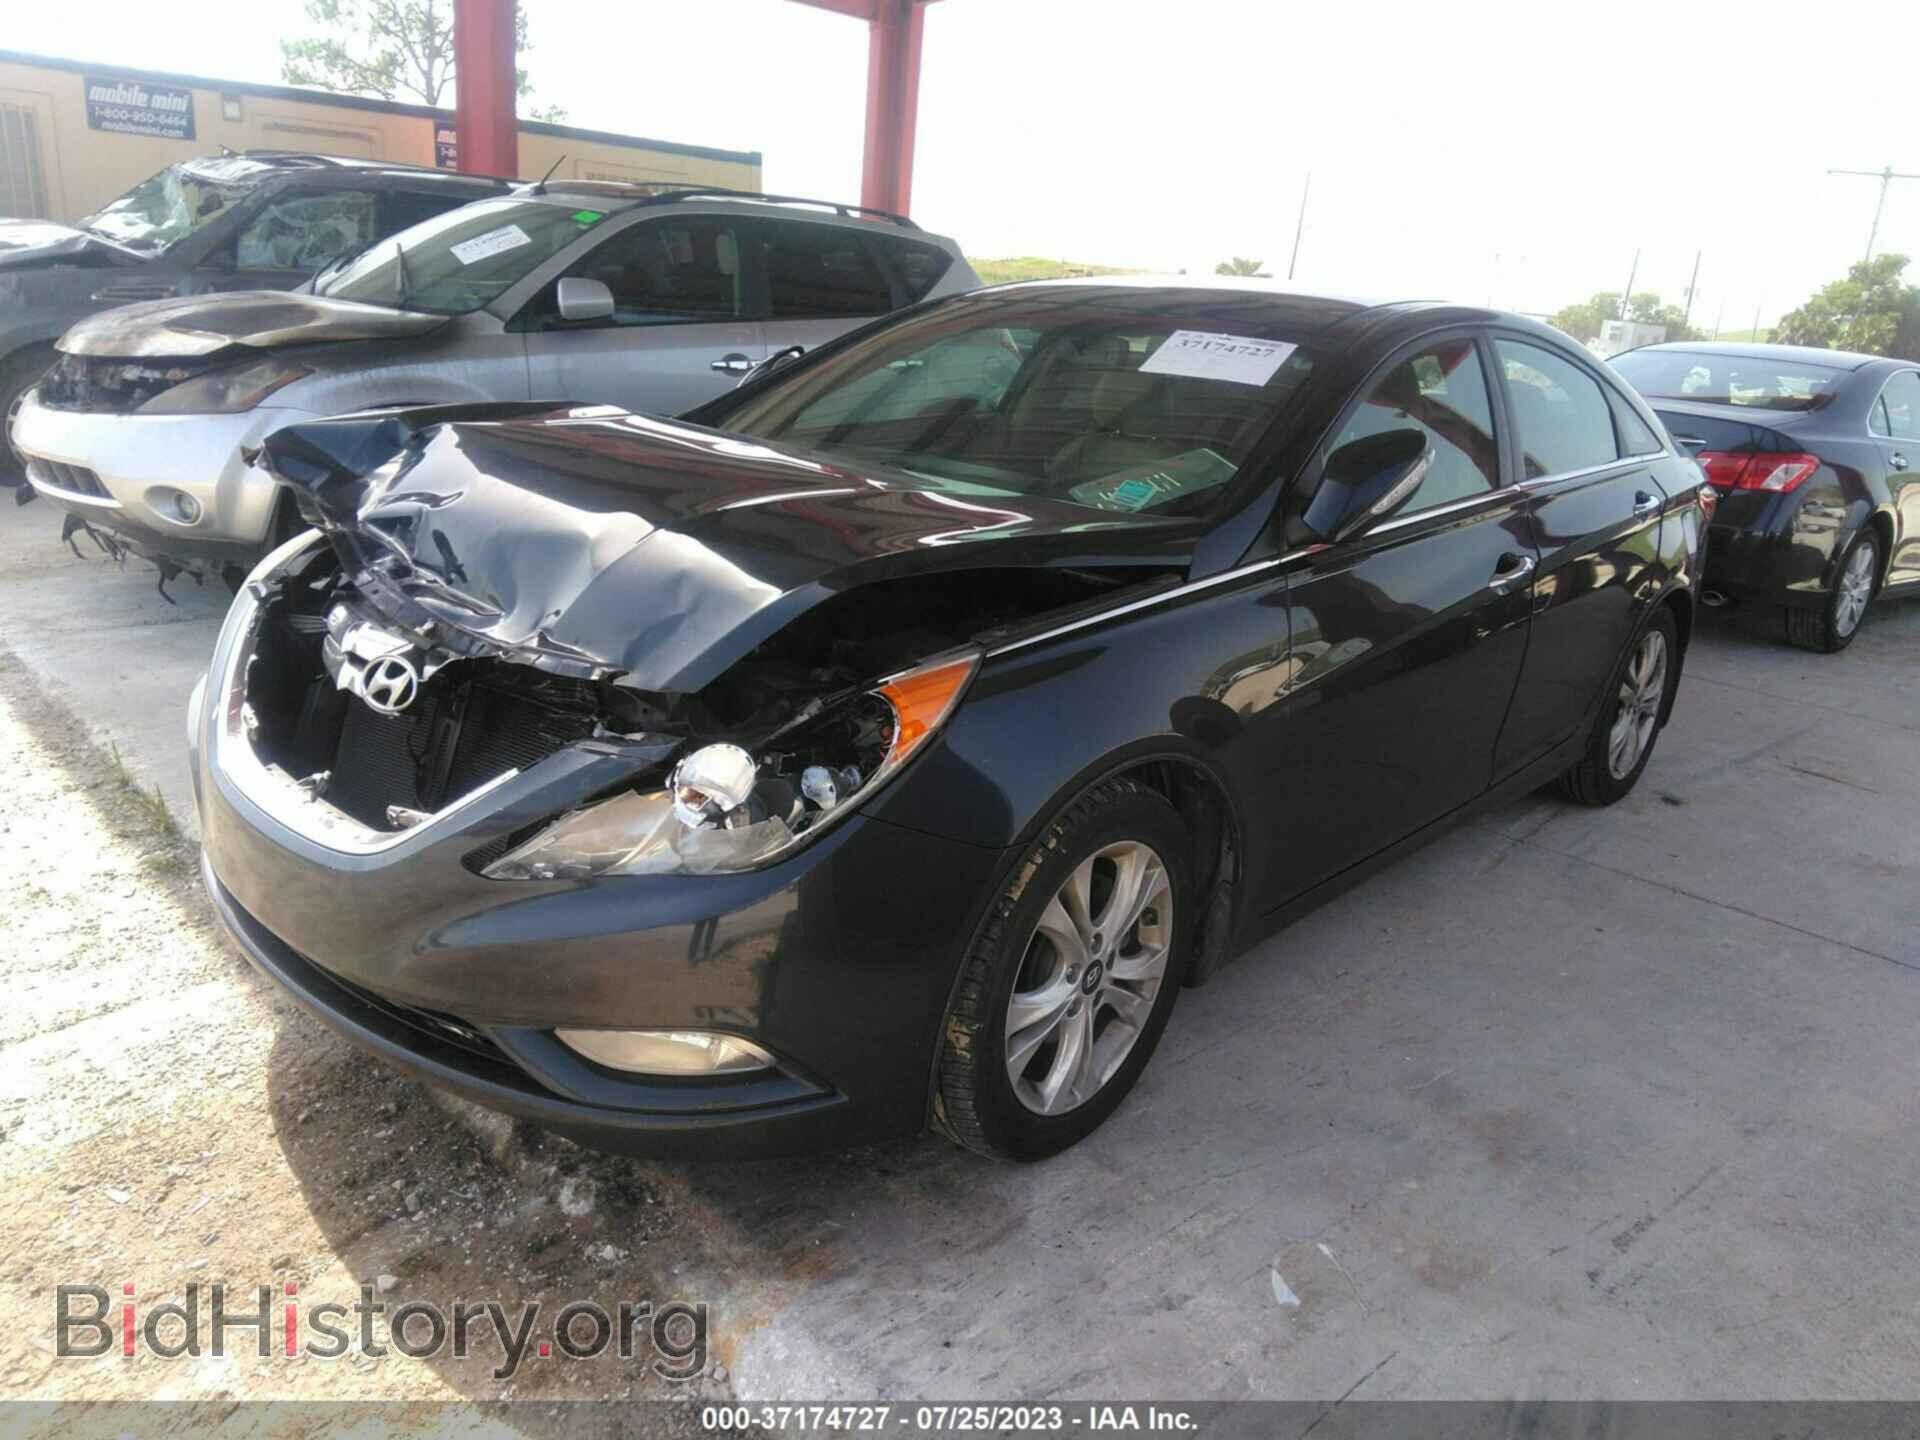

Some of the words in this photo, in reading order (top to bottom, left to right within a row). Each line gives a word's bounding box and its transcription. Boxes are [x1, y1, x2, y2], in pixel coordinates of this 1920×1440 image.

[88, 83, 148, 107] mobile
[151, 93, 190, 112] mini
[1176, 339, 1275, 358] 37174727
